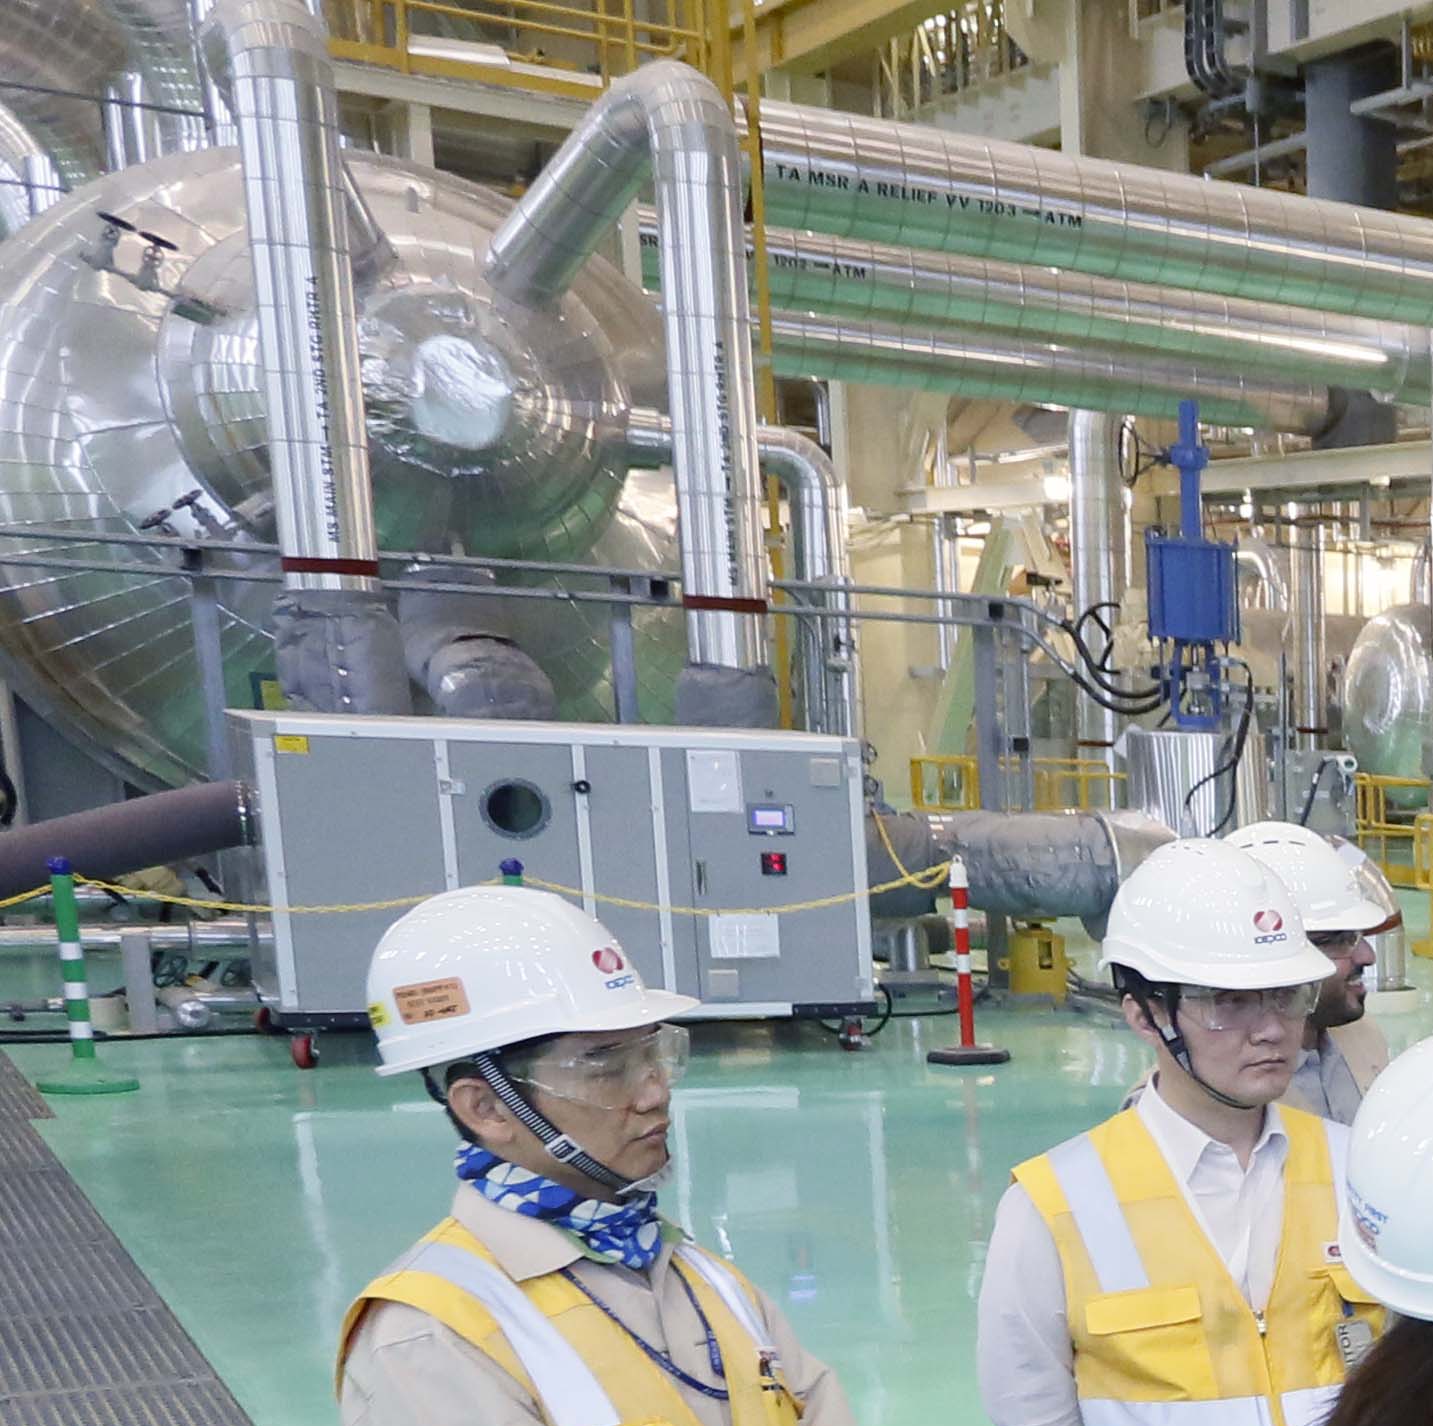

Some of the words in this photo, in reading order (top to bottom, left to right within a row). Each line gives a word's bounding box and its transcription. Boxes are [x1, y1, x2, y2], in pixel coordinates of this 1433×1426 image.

[775, 163, 801, 181] TA
[807, 169, 849, 190] MSR
[857, 179, 870, 195] A
[876, 182, 938, 205] RELIEF
[1044, 211, 1084, 229] ATM
[640, 233, 658, 248] SR
[831, 261, 867, 280] ATM
[309, 335, 325, 363] STG
[311, 369, 328, 395] 2ND
[315, 401, 331, 420] TA
[319, 445, 334, 477] STM
[323, 481, 338, 518] MAIN
[1338, 1323, 1356, 1364] ITOR
